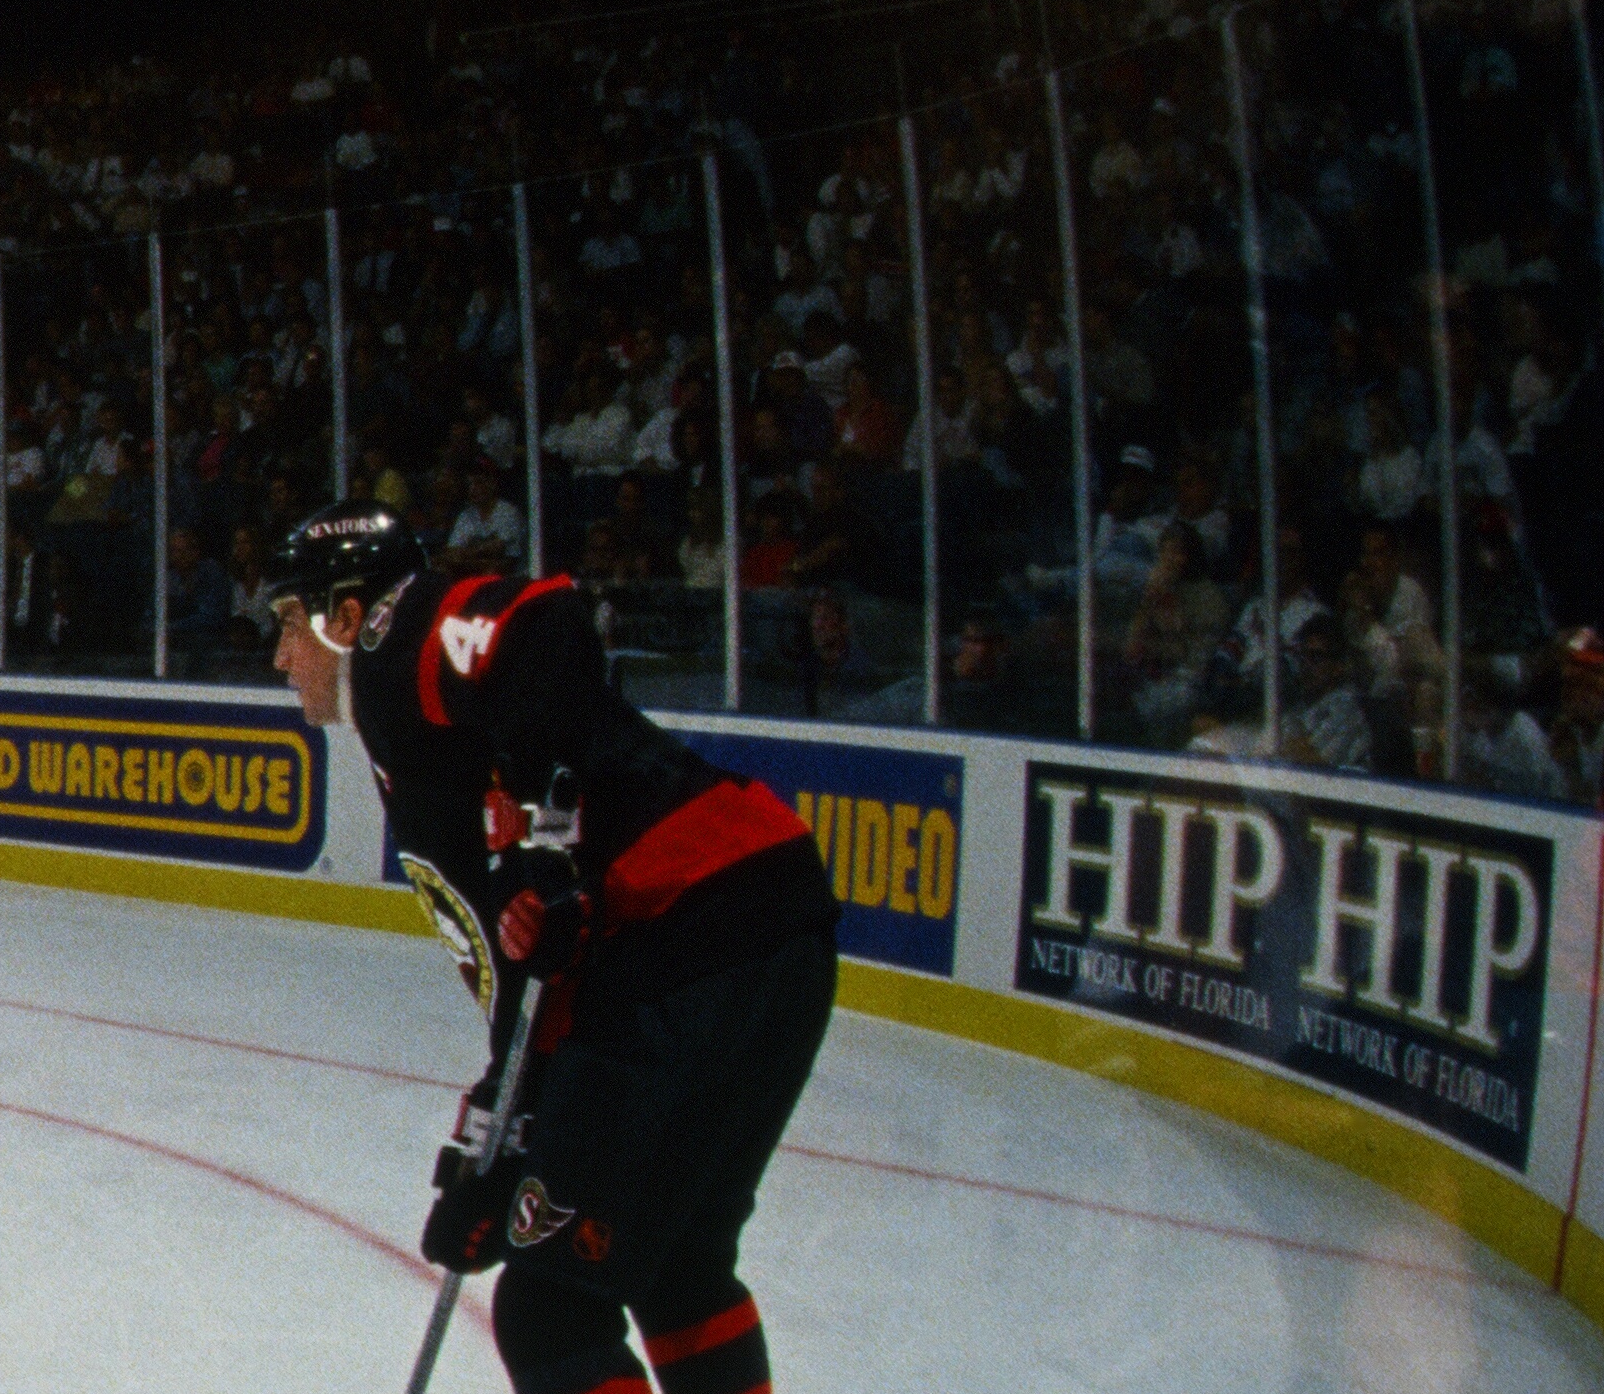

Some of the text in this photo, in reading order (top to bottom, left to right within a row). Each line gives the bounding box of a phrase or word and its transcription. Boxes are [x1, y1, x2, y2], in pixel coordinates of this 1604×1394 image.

[307, 516, 383, 540] SENATORS
[439, 614, 497, 675] 4
[27, 739, 291, 815] WAREHOUSE
[795, 790, 956, 921] VIDEO
[1033, 783, 1285, 967] HIP
[1031, 939, 1272, 1031] NETWORK OF FLORIDA
[1300, 818, 1539, 1050] HIP
[1295, 1005, 1521, 1133] NETWORK OF FLORIDA
